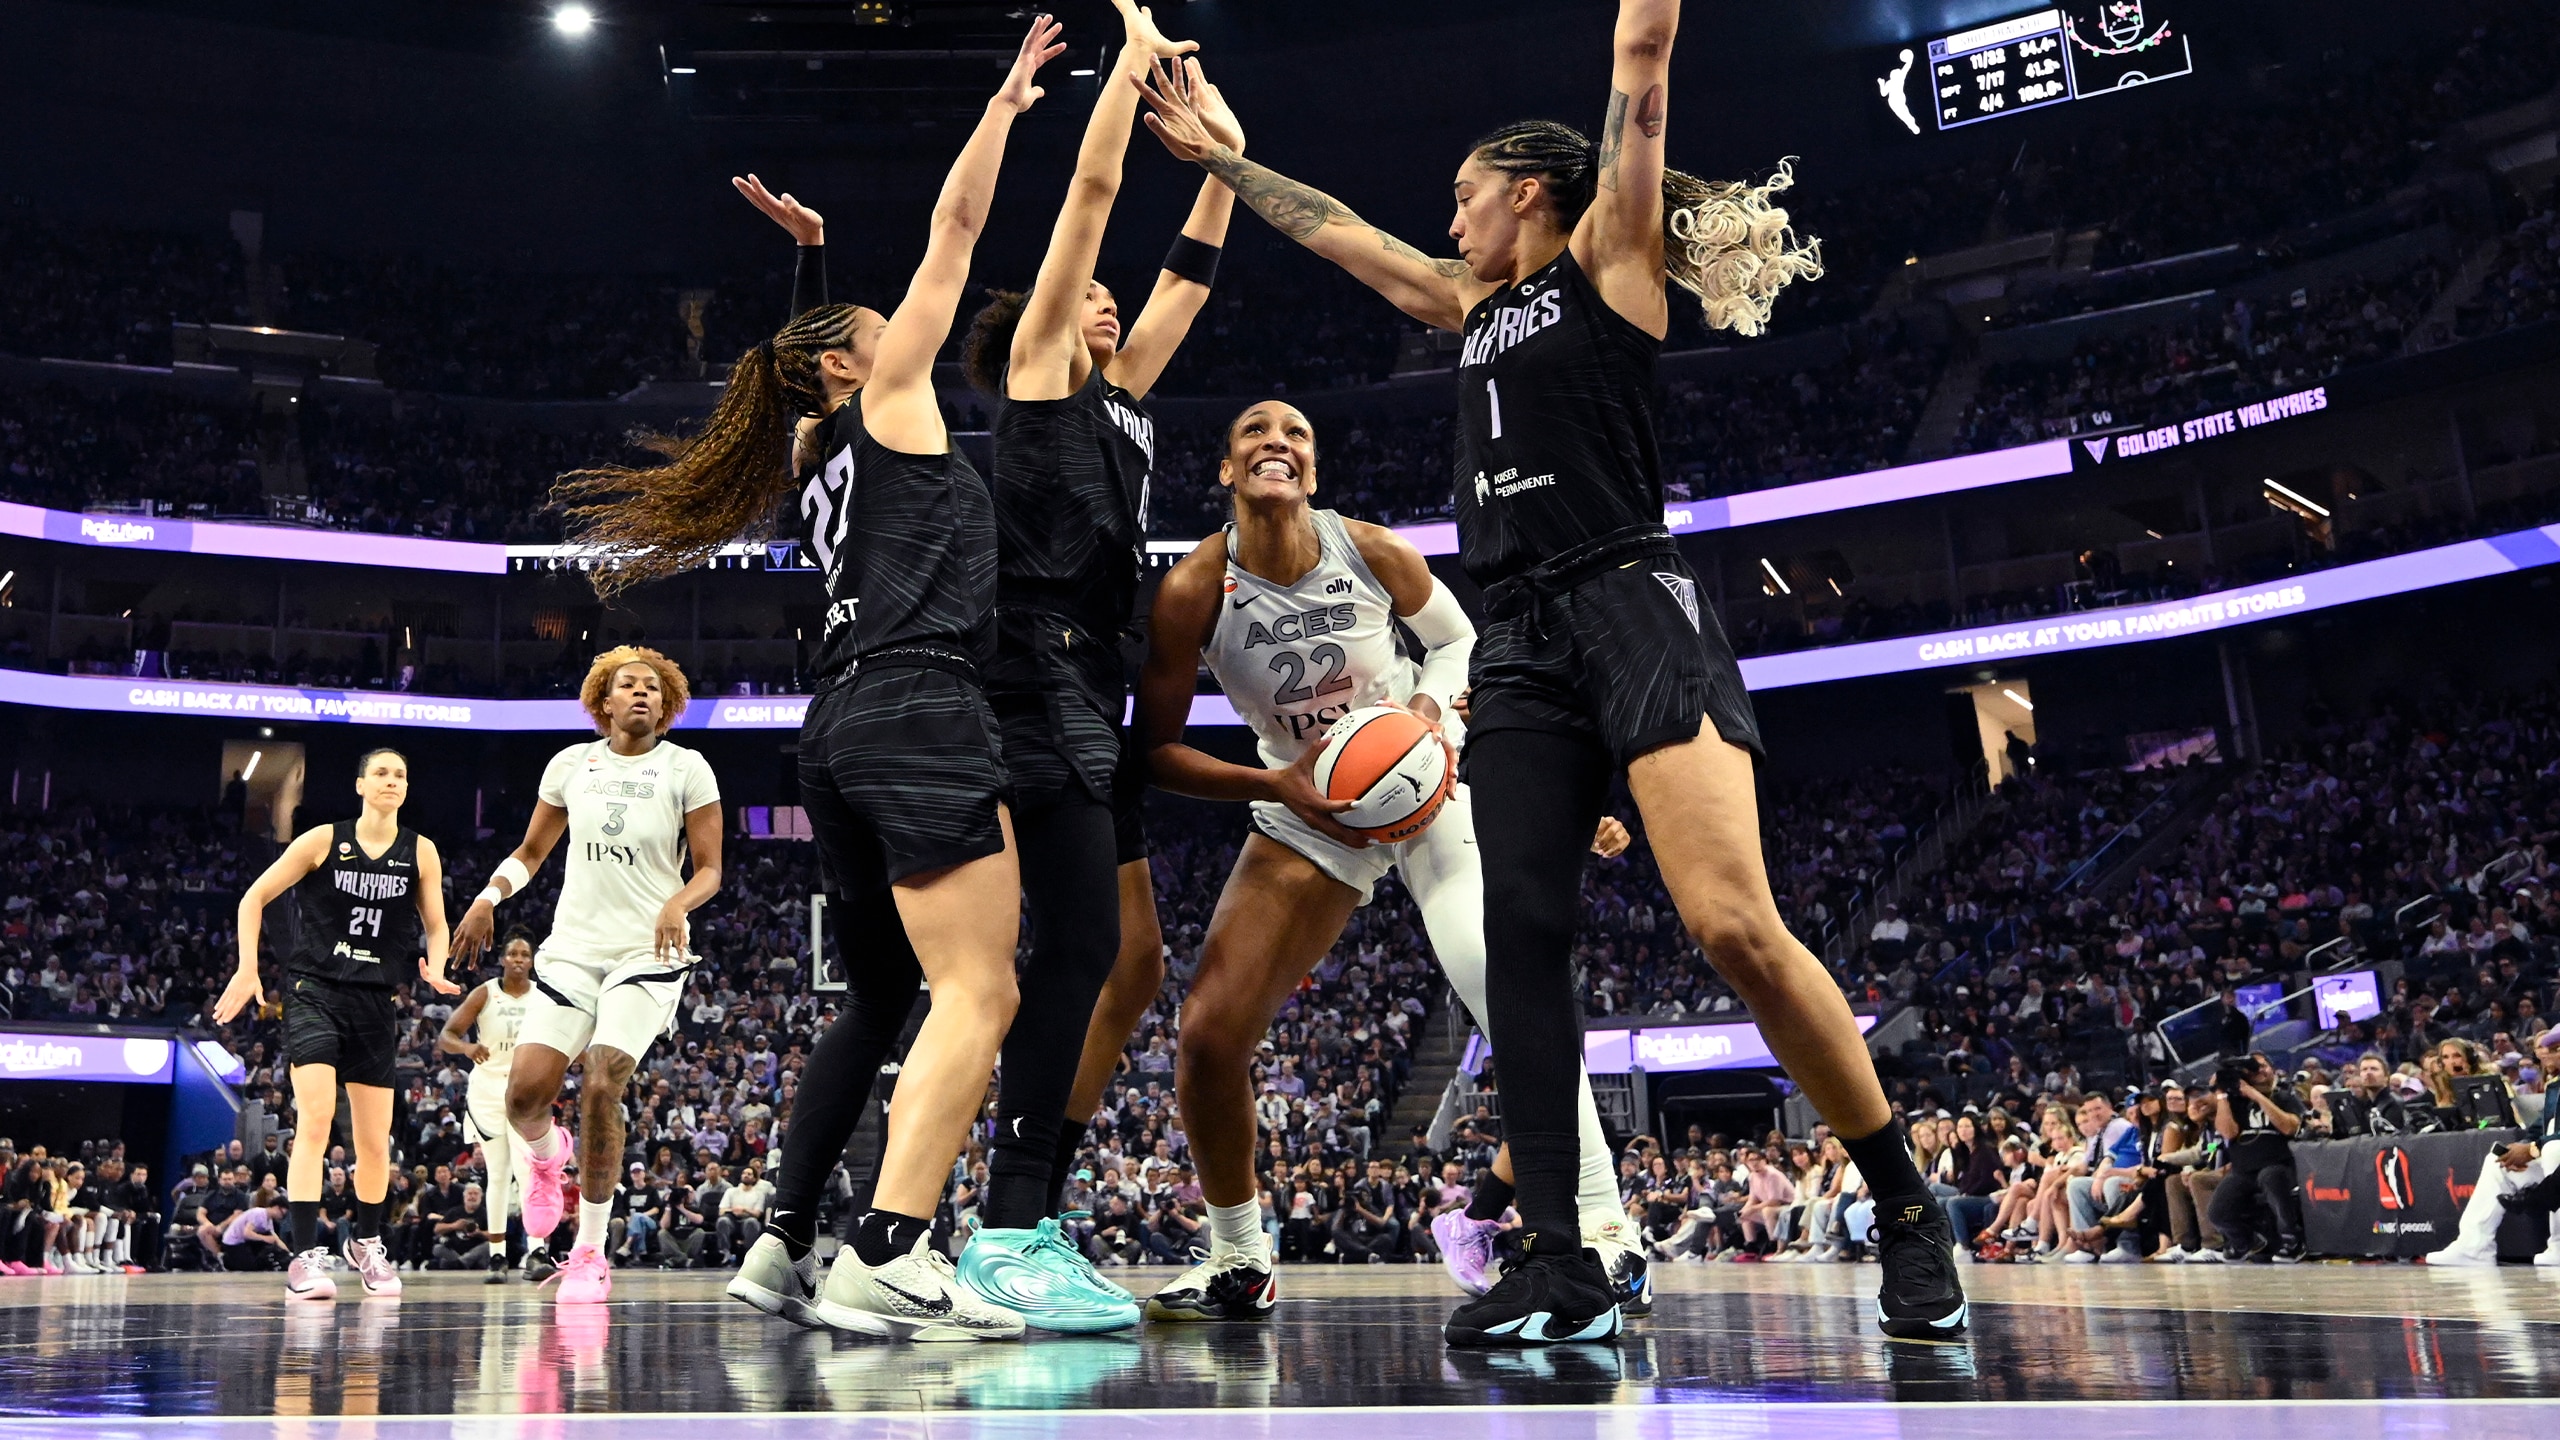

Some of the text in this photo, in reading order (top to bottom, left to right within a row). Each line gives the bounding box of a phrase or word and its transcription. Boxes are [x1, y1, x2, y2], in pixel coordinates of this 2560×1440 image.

[1487, 378, 1501, 439] 1
[2117, 387, 2327, 458] GOLDEN STATE VALKYRIES
[1494, 467, 1518, 485] KAISER
[1495, 474, 1556, 498] PERMANENTE
[81, 518, 154, 543] Rakuten
[1326, 577, 1353, 596] ally
[1244, 603, 1357, 650] ACES
[1919, 586, 2306, 661] CASH BACK AT YOUR FAVORITE STORES
[1268, 643, 1352, 705] 22
[128, 688, 471, 723] CASH BACK AT YOUR FAVORITE STORES
[723, 706, 808, 722] CASH BAC
[641, 769, 660, 779] ally
[584, 779, 655, 799] ACES
[601, 802, 628, 837] 3
[586, 842, 640, 866] IPSY
[334, 870, 409, 901] VALKYRIES
[349, 906, 383, 938] 24
[498, 1006, 526, 1016] ACE
[0, 1039, 82, 1068] akuten
[1637, 1033, 1732, 1062] Rakuten
